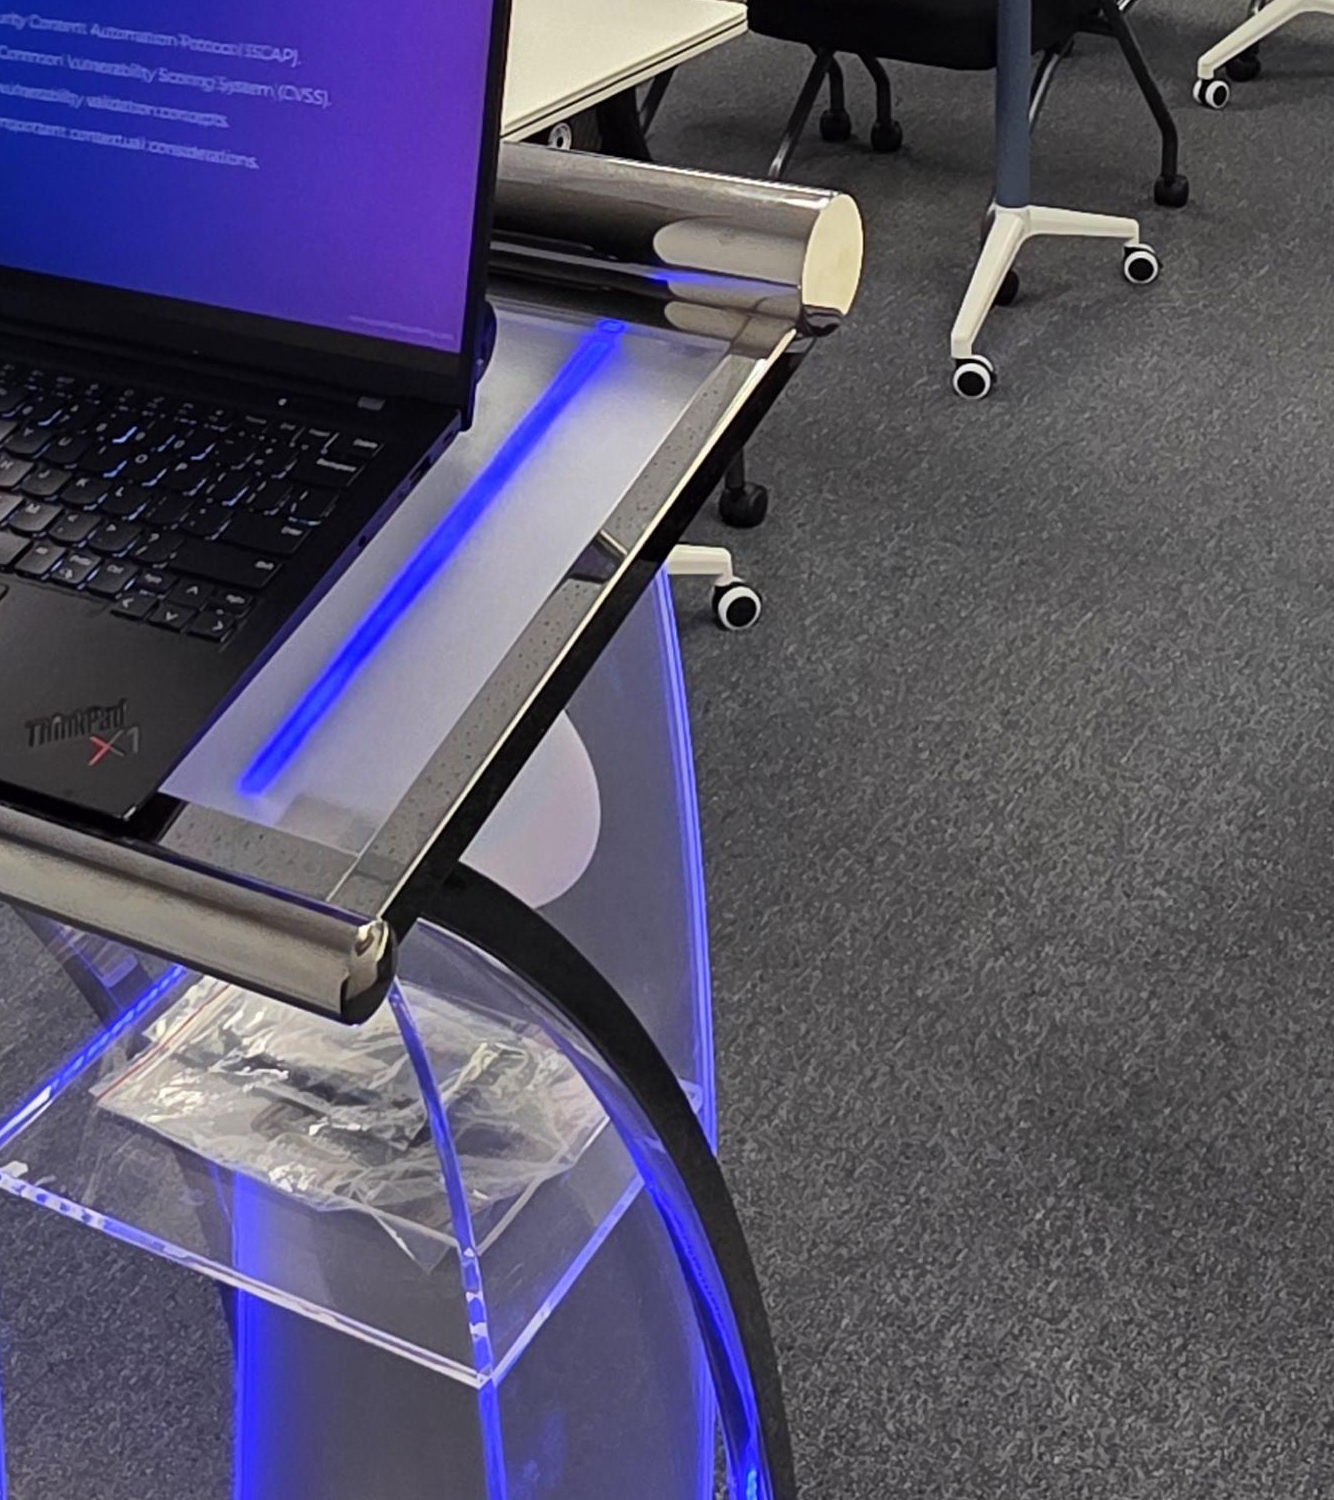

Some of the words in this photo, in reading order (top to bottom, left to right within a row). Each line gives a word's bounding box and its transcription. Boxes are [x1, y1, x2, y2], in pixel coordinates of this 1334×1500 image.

[29, 14, 87, 34] Content
[90, 23, 177, 48] Automation
[67, 54, 156, 83] Vulnerability
[158, 68, 216, 93] Scoring
[218, 76, 275, 98] System
[69, 127, 146, 151] contextual
[25, 697, 128, 747] ThinkPad
[88, 725, 141, 766] X1
